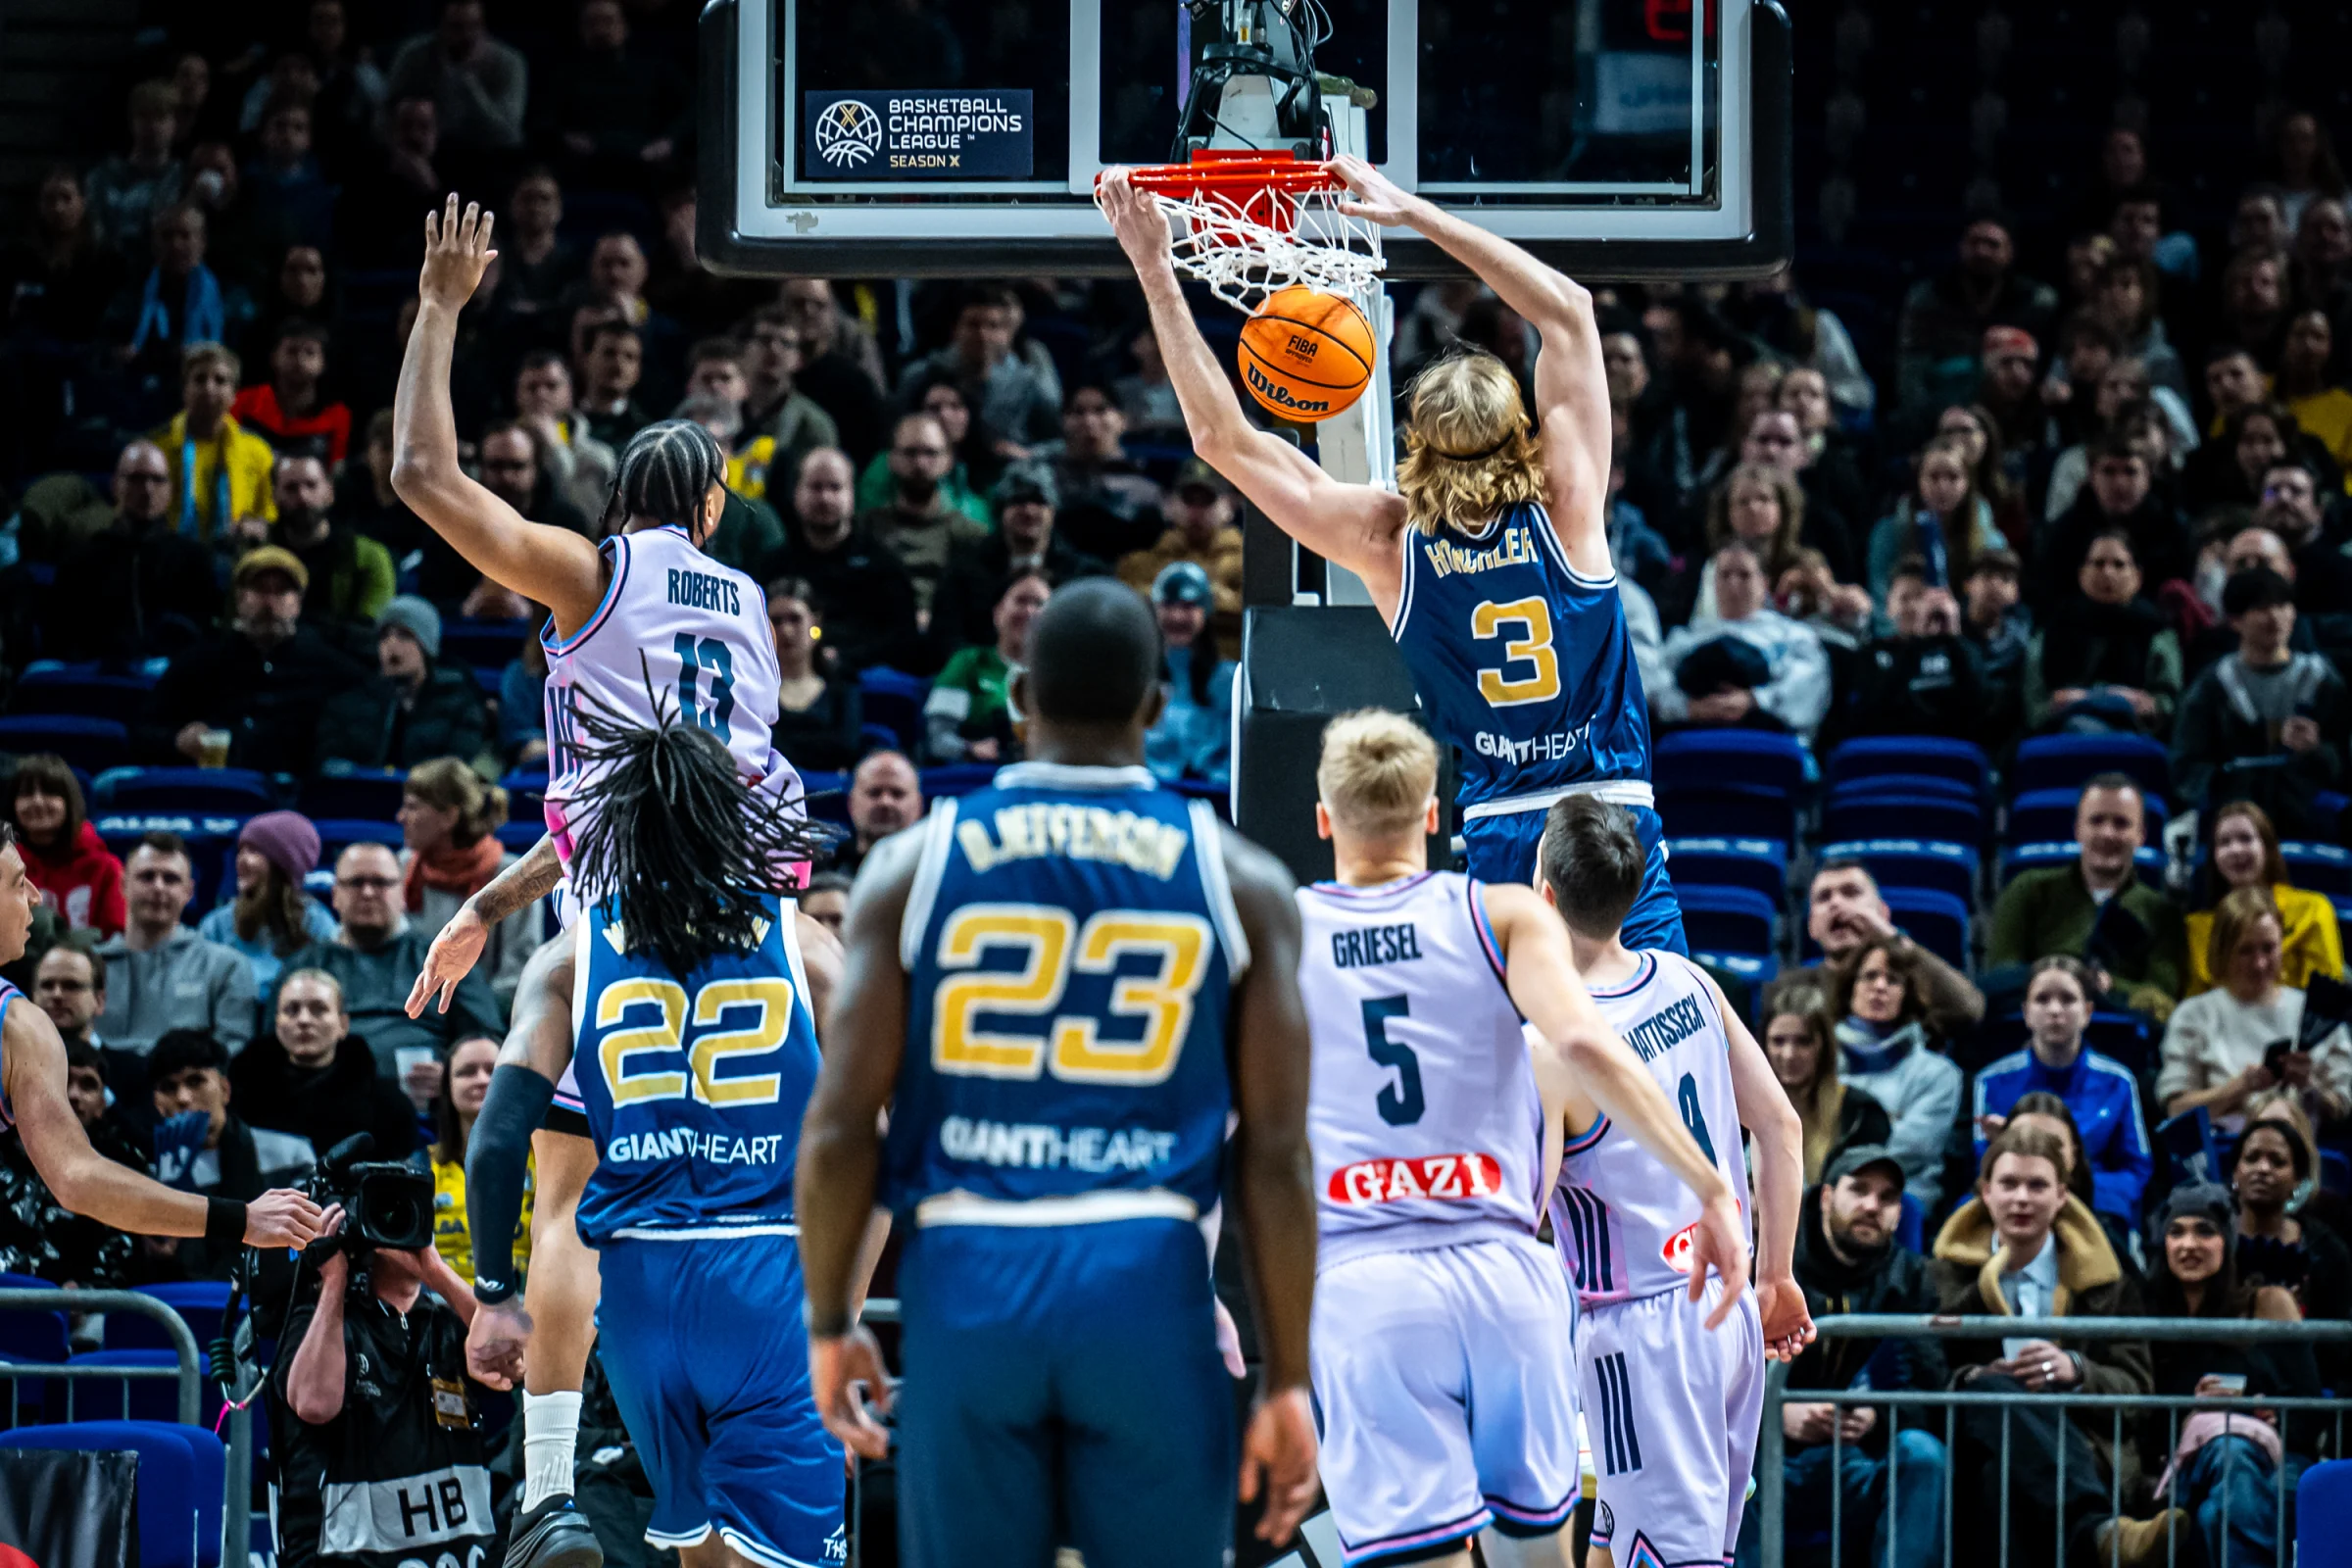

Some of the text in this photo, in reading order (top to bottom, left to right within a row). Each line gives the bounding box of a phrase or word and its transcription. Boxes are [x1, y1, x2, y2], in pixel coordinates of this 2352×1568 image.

[889, 98, 1007, 114] BASKETBALL
[889, 115, 1022, 132] CHAMPIONS
[889, 133, 960, 149] LEAGUE
[890, 155, 960, 168] SEASON X
[1287, 334, 1318, 357] FIBA
[1248, 361, 1330, 412] Wilson
[667, 568, 740, 616] ROBERTS
[1471, 595, 1561, 708] 3
[674, 631, 735, 747] 13
[1475, 713, 1596, 766] GIANTHEA
[1333, 922, 1422, 968] GRIESEL
[930, 901, 1213, 1088] 23
[596, 977, 794, 1109] 22
[1361, 993, 1425, 1126] 5
[608, 1127, 782, 1165] GIANTHEART
[397, 1477, 467, 1538] HB
